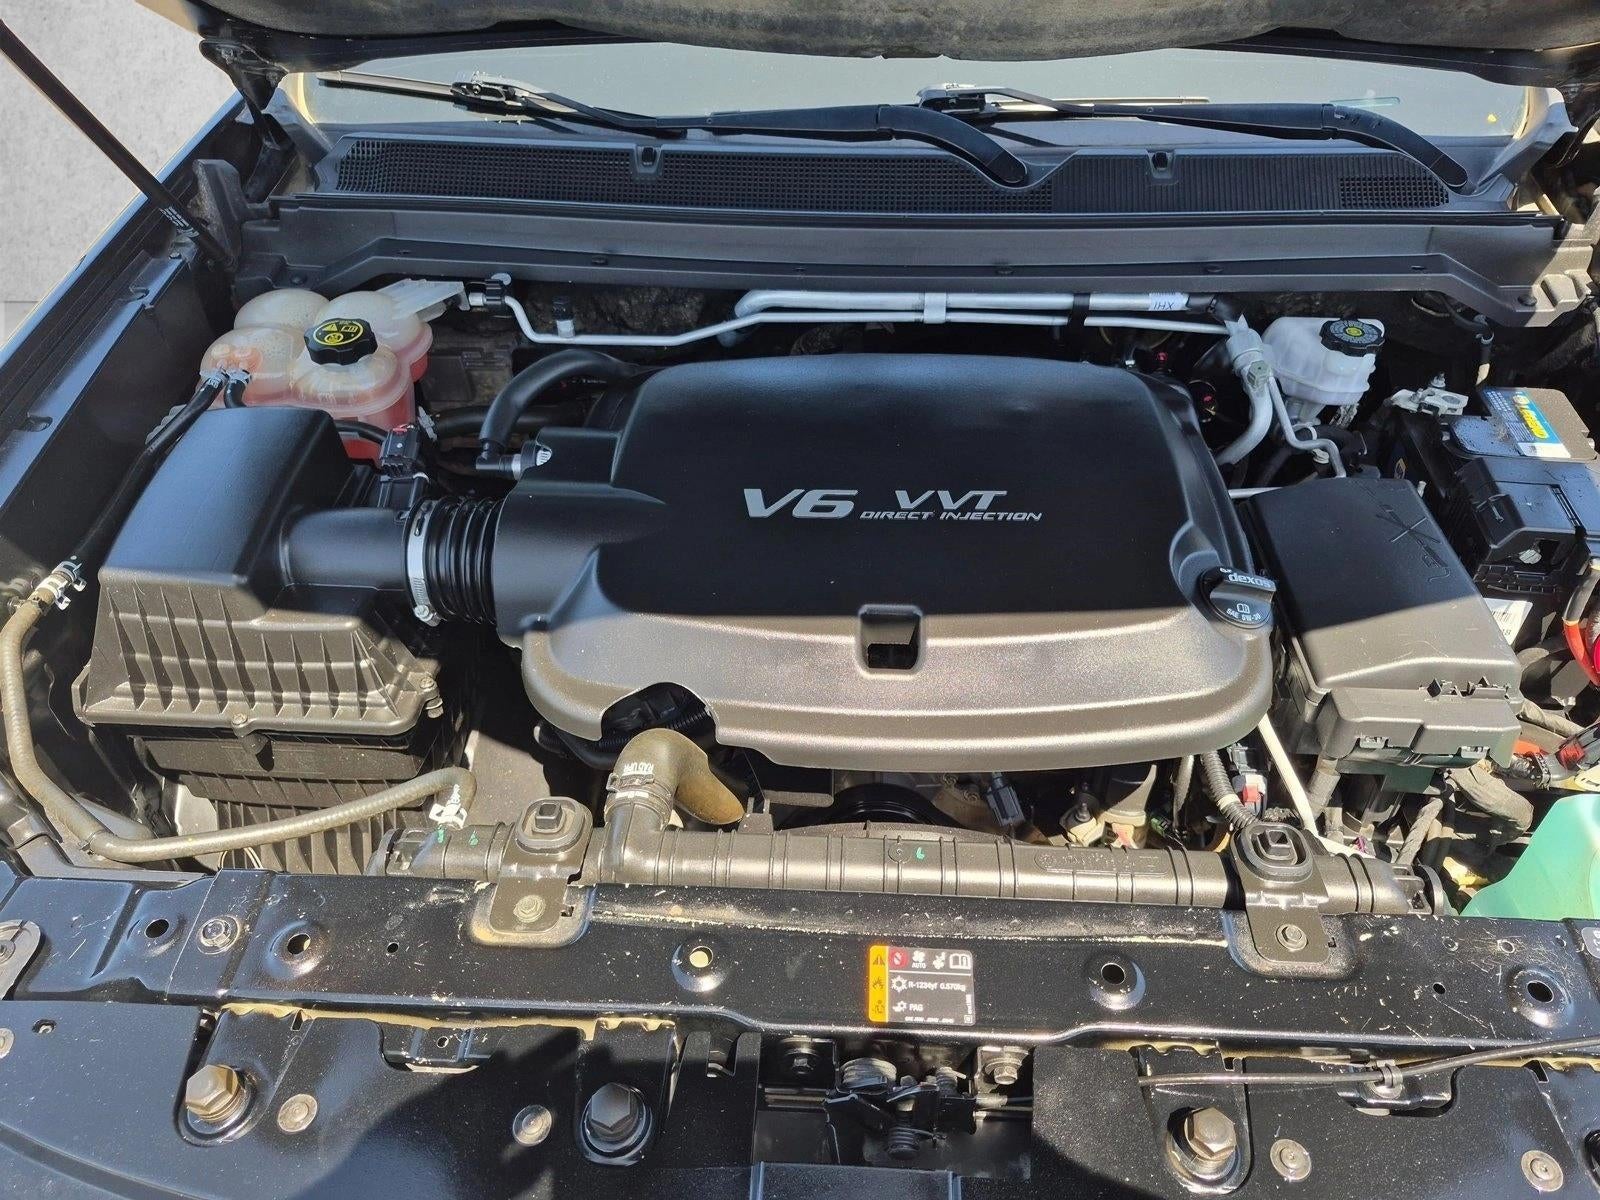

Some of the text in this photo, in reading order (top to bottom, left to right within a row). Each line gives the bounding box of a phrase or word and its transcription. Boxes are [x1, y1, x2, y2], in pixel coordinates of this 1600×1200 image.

[743, 488, 858, 519] V6
[895, 490, 1008, 510] VVT
[859, 510, 1043, 522] DIRECT INJECTION
[1228, 572, 1272, 588] dexos
